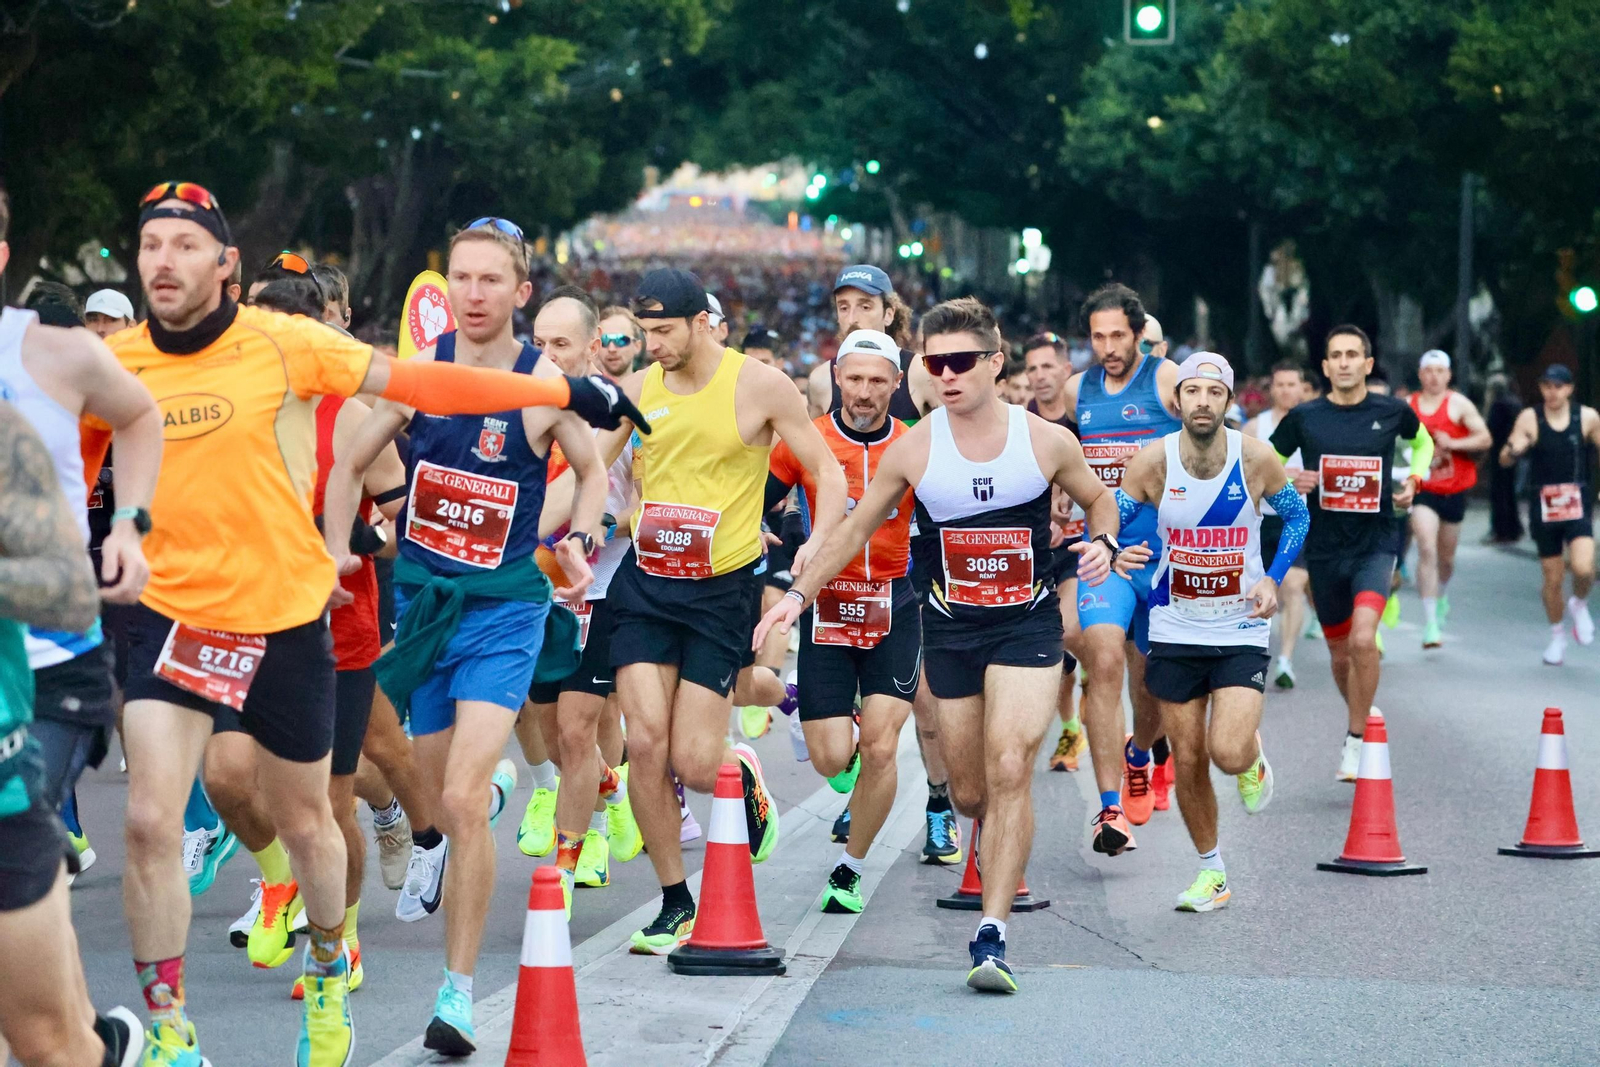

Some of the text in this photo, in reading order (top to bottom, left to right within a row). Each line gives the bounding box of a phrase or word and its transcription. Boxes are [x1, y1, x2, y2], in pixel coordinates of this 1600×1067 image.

[840, 271, 872, 282] HOKA
[163, 404, 221, 427] ALBIS
[483, 416, 509, 429] KENT
[444, 473, 511, 499] GENERALI
[972, 477, 993, 486] SCUF
[436, 499, 485, 525] 2016
[448, 519, 469, 529] PETER
[655, 529, 692, 546] 3088
[966, 533, 1024, 545] GENERALI
[1166, 526, 1249, 548] MADRID
[966, 557, 1009, 572] 3086
[1187, 554, 1239, 566] GENERALI
[1183, 574, 1228, 589] 10179
[839, 602, 866, 617] 555
[197, 645, 254, 673] 5716
